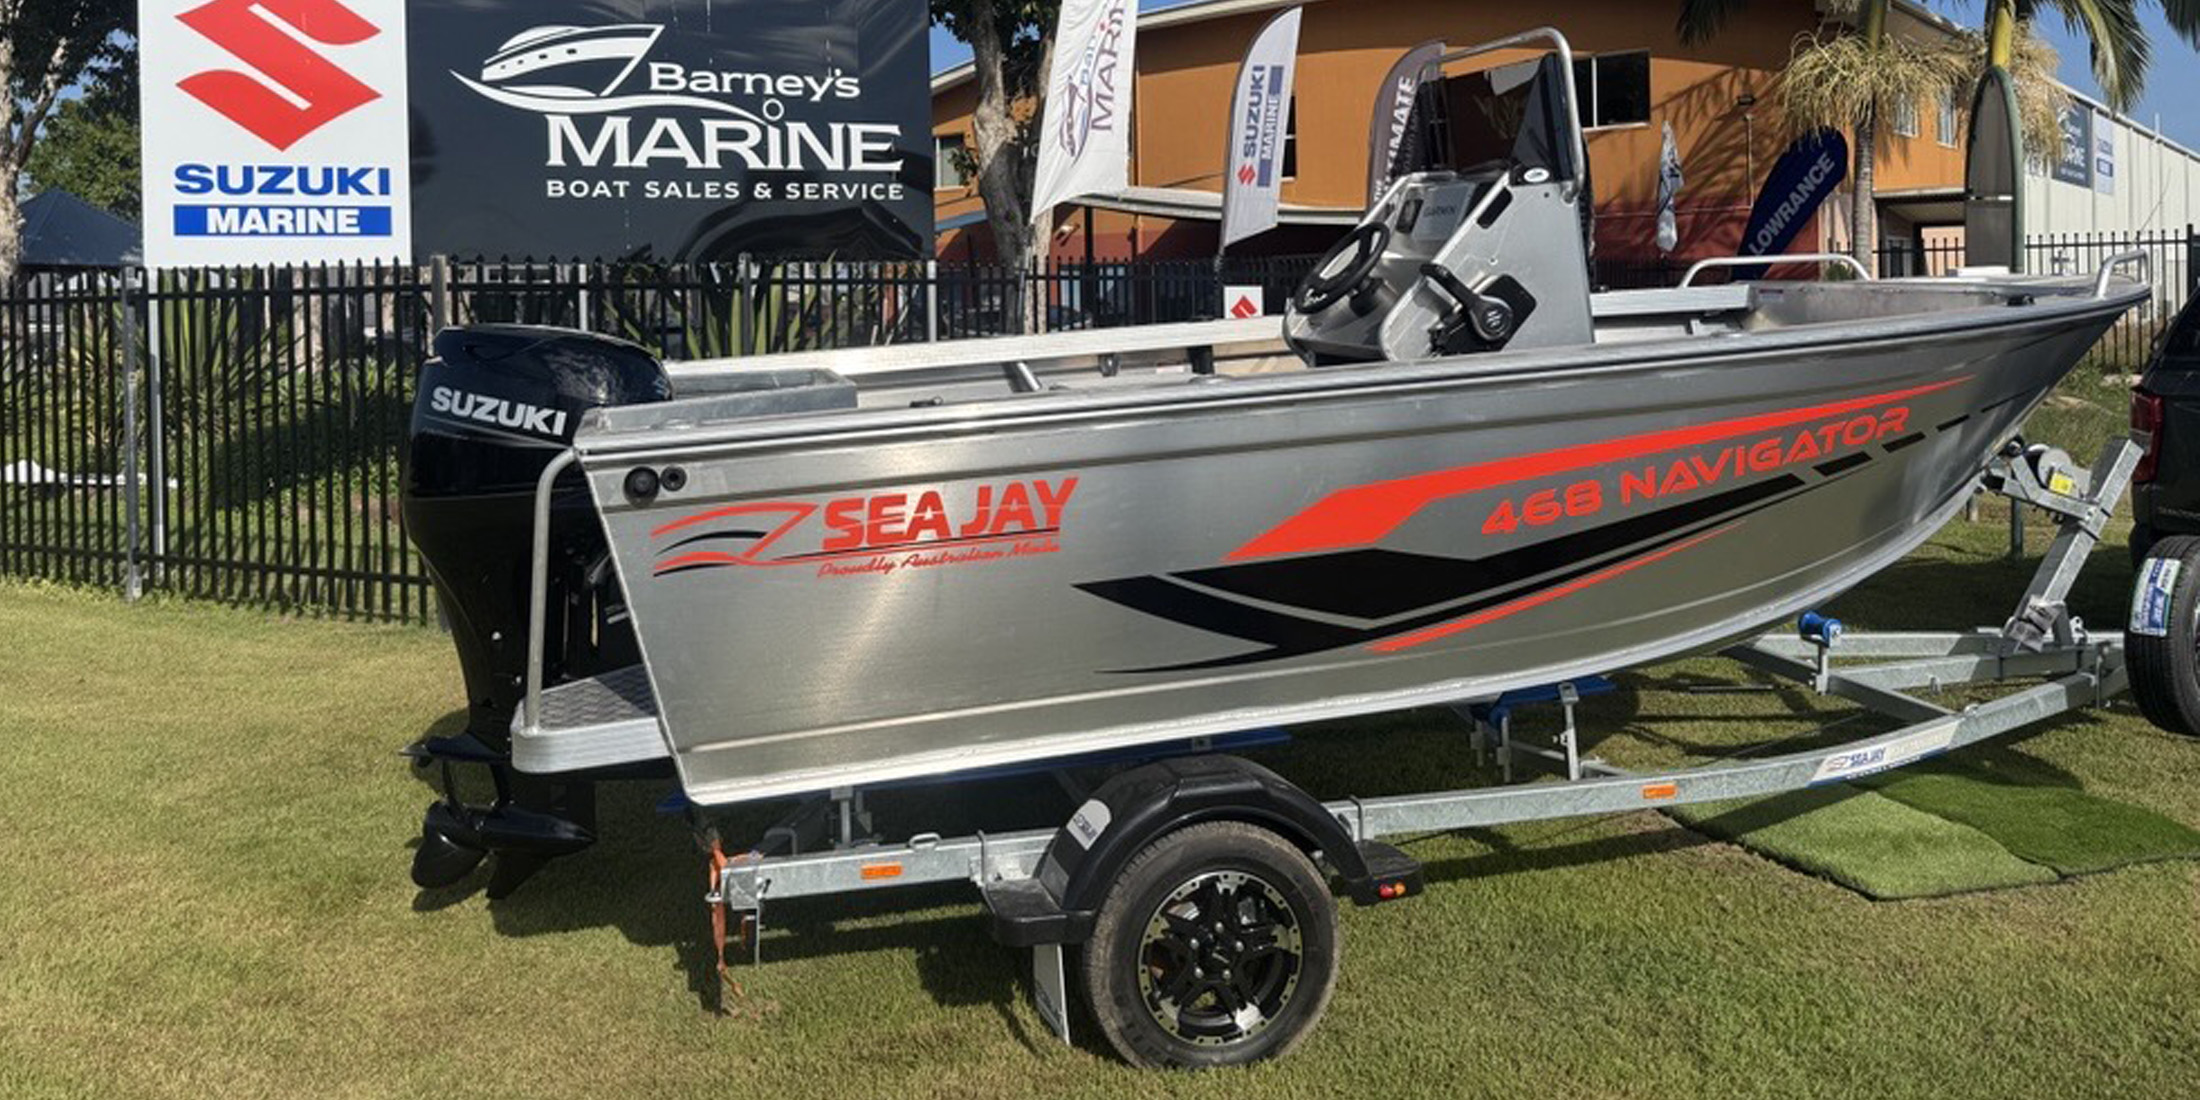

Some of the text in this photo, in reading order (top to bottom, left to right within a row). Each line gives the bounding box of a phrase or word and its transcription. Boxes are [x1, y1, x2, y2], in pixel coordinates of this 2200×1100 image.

[649, 62, 861, 101] Barney's
[1243, 65, 1265, 158] SUZUKI
[1260, 95, 1280, 160] MARINE
[174, 163, 391, 196] SUZUKI
[546, 180, 904, 201] BOAT SALES & SERVICE
[1748, 151, 1836, 256] LOWRANCE
[206, 206, 362, 235] MARINE
[430, 386, 568, 437] SUZUKI
[1480, 405, 1911, 536] 468 NAVIGATOR
[821, 475, 1081, 551] SEA JAY
[816, 539, 1062, 579] Proudly Australian Made
